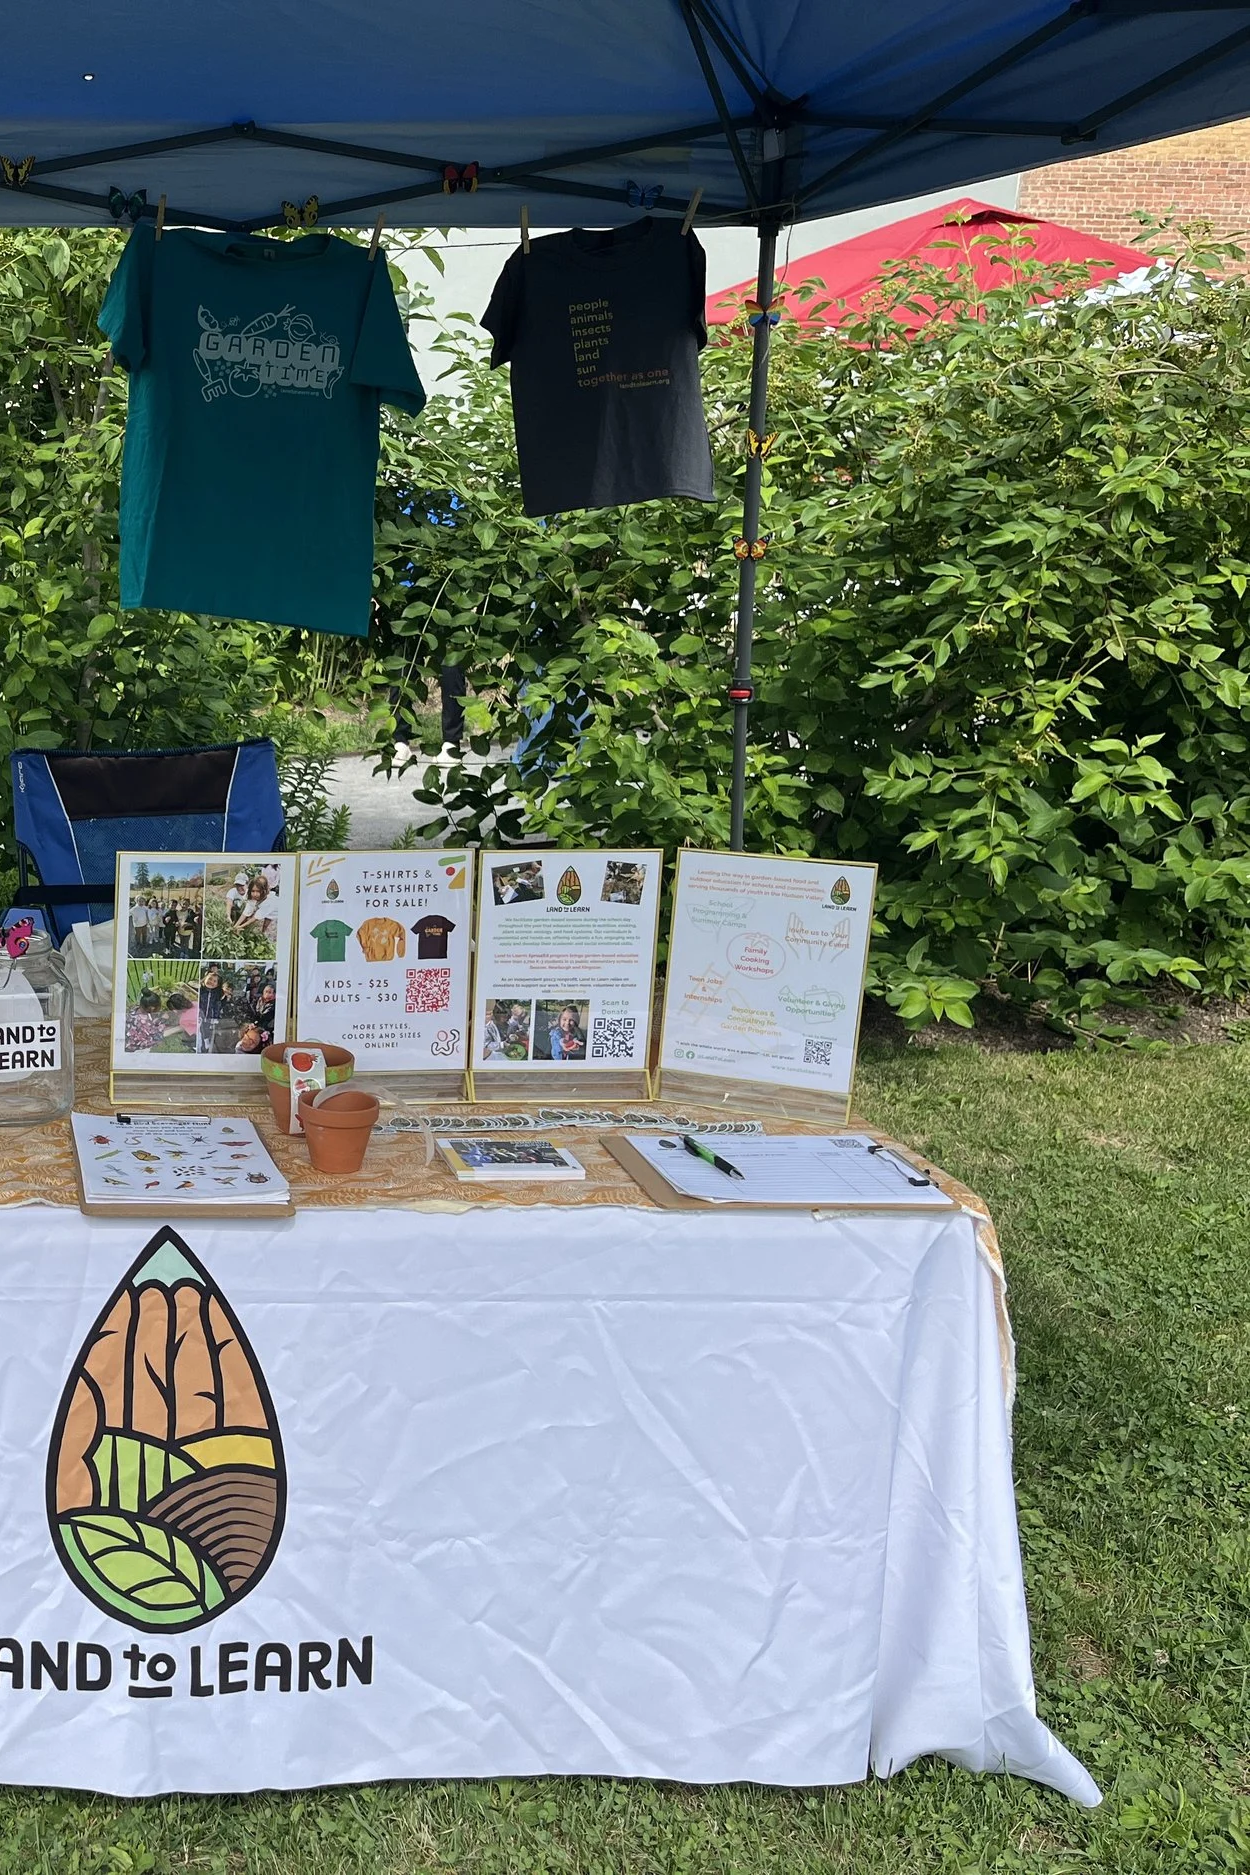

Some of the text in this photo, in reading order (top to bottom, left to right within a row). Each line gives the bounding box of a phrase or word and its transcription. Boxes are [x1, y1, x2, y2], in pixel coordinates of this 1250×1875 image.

[569, 298, 609, 314] people
[570, 310, 613, 324] animals
[572, 324, 611, 337] insects
[205, 332, 336, 364] GARDEN
[573, 337, 609, 351] plants
[575, 349, 600, 362] land
[265, 364, 325, 383] TIME
[577, 365, 596, 375] sun
[577, 368, 669, 388] together as one
[362, 869, 433, 879] T-SHIRTS &
[355, 884, 439, 894] SWEATSHIRTS
[365, 898, 428, 908] FOR SALE!
[708, 900, 734, 909] School
[692, 907, 741, 920] Programming
[692, 916, 747, 929] Summer Camps
[789, 927, 809, 935] Invite
[830, 930, 849, 939] Your
[785, 936, 850, 949] Community Event
[744, 946, 768, 956] Family
[740, 955, 770, 965] Cooking
[735, 964, 774, 975] Workshops
[324, 980, 352, 988] KIDS
[369, 979, 389, 988] $25
[689, 975, 723, 985] Teen Jobs
[314, 994, 361, 1003] ADULTS
[377, 993, 398, 1002] $30
[684, 993, 723, 1004] Internships
[778, 995, 814, 1006] Volunteer
[823, 1000, 846, 1010] Giving
[731, 1006, 768, 1017] Resources
[786, 1006, 836, 1018] Opportunities
[727, 1014, 765, 1027] Consulting
[39, 1024, 56, 1043] to
[720, 1022, 782, 1038] Garden Programs
[123, 1644, 176, 1697] to
[190, 1636, 372, 1696] LEARN
